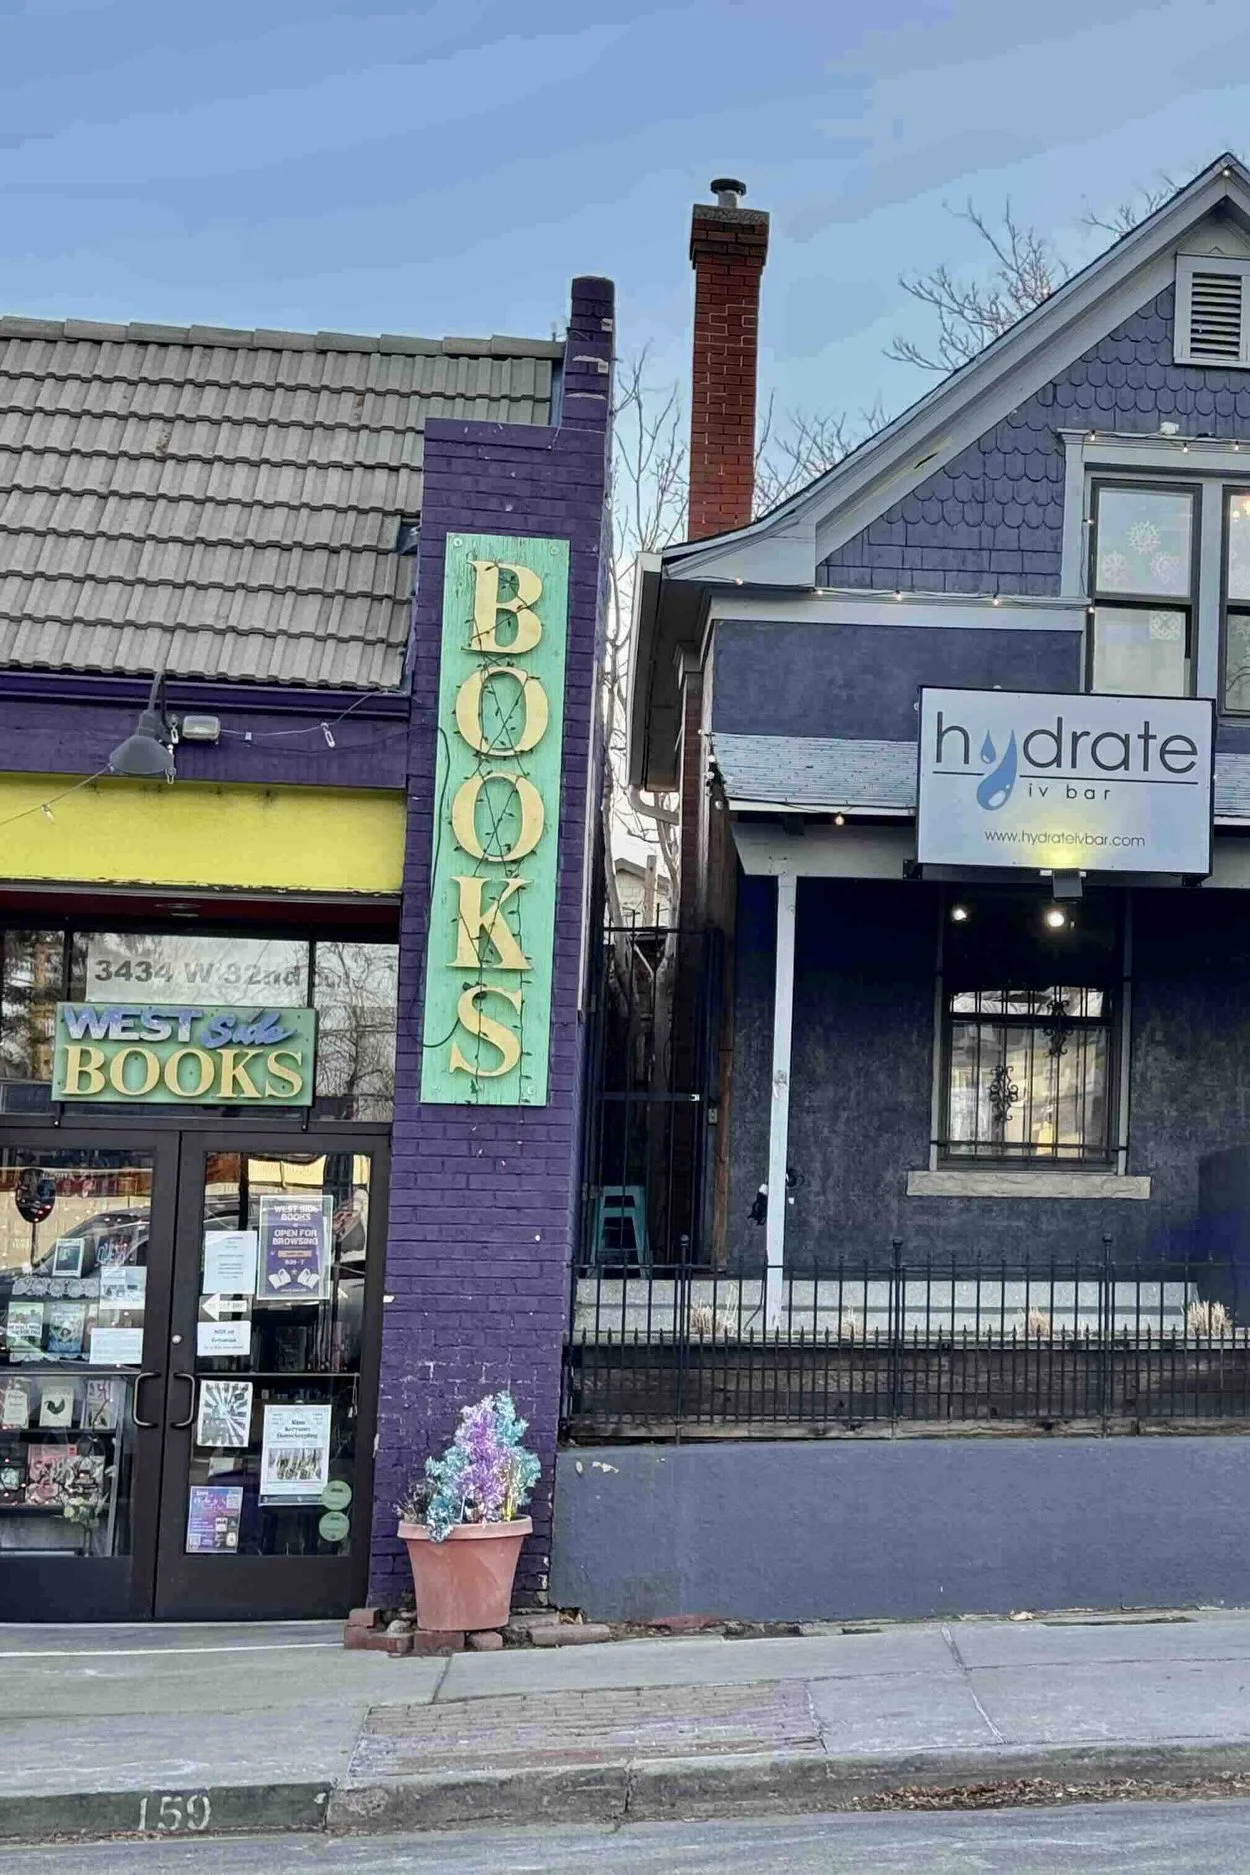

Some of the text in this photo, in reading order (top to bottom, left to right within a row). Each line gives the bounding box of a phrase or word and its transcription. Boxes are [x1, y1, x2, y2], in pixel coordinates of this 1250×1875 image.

[936, 711, 1198, 811] hydrate
[1028, 782, 1112, 801] iv bar
[447, 560, 549, 1078] BOOKS
[984, 830, 1146, 847] www.hydrateivbar.com
[94, 959, 174, 983] 3434
[184, 961, 214, 984] W
[63, 1005, 298, 1049] WEST Side
[60, 1044, 303, 1099] BOOKS
[272, 1237, 318, 1245] BROWSING
[274, 1229, 317, 1237] OPEN FOR
[138, 1794, 211, 1832] 159
